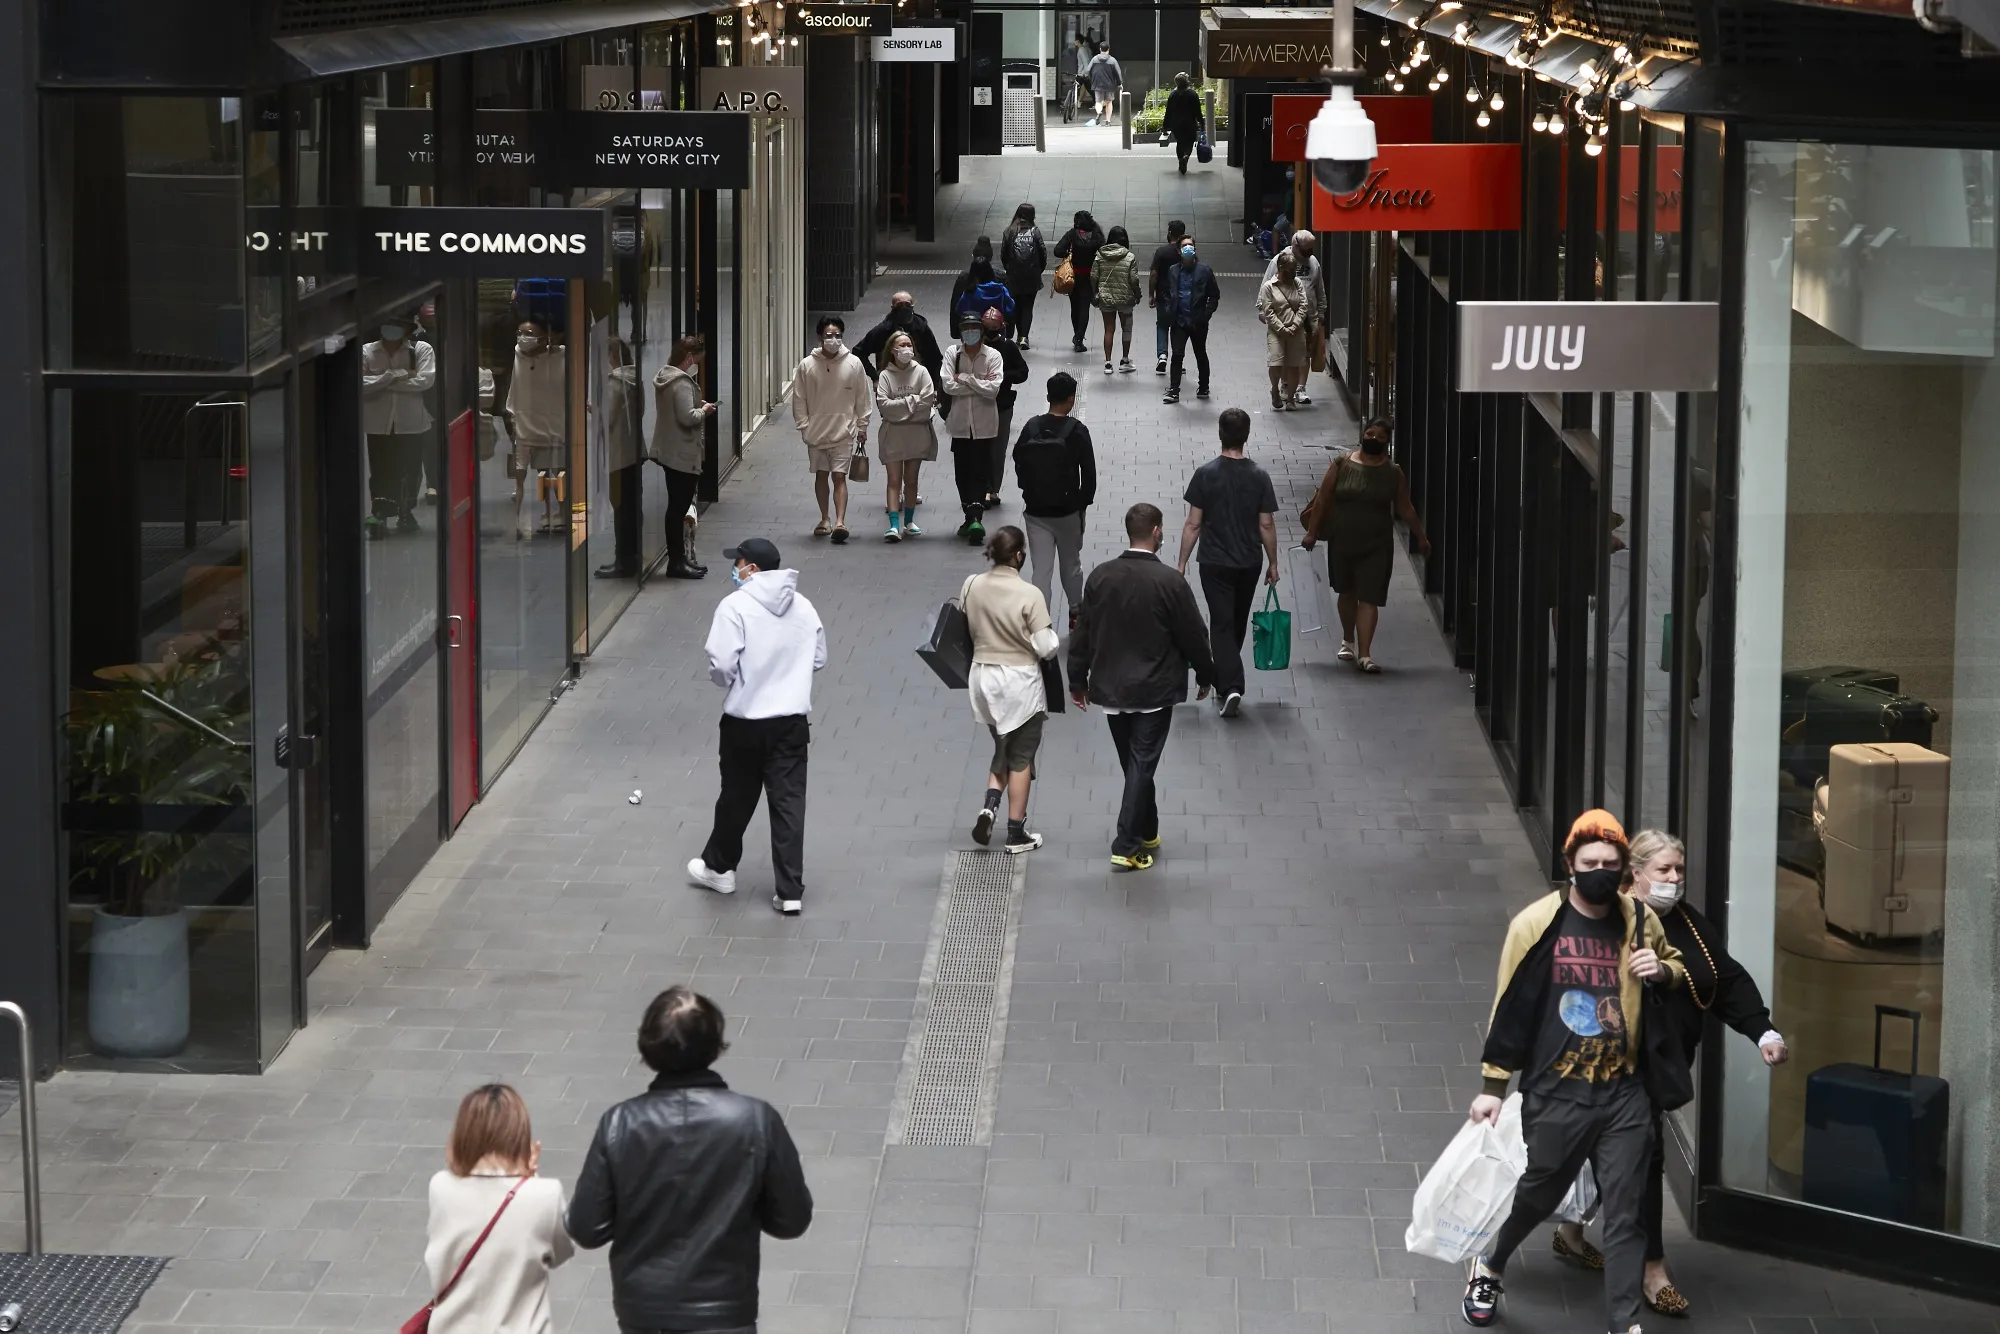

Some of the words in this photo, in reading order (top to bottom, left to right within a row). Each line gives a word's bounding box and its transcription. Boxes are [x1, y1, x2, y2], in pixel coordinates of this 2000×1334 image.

[805, 12, 873, 28] ascolour.
[883, 40, 923, 50] SENSORY
[925, 40, 943, 50] LAB
[1218, 43, 1367, 63] ZIMMERMAN
[712, 91, 789, 114] A.P.C.
[612, 135, 704, 148] SATURDAYS
[595, 153, 631, 165] NEW
[637, 153, 680, 166] YORK
[685, 153, 721, 166] CITY
[375, 231, 431, 252] THE
[439, 232, 586, 254] COMMONS
[1491, 325, 1586, 371] JULY
[1553, 936, 1618, 960] PUBL
[1552, 965, 1618, 988] ENEM
